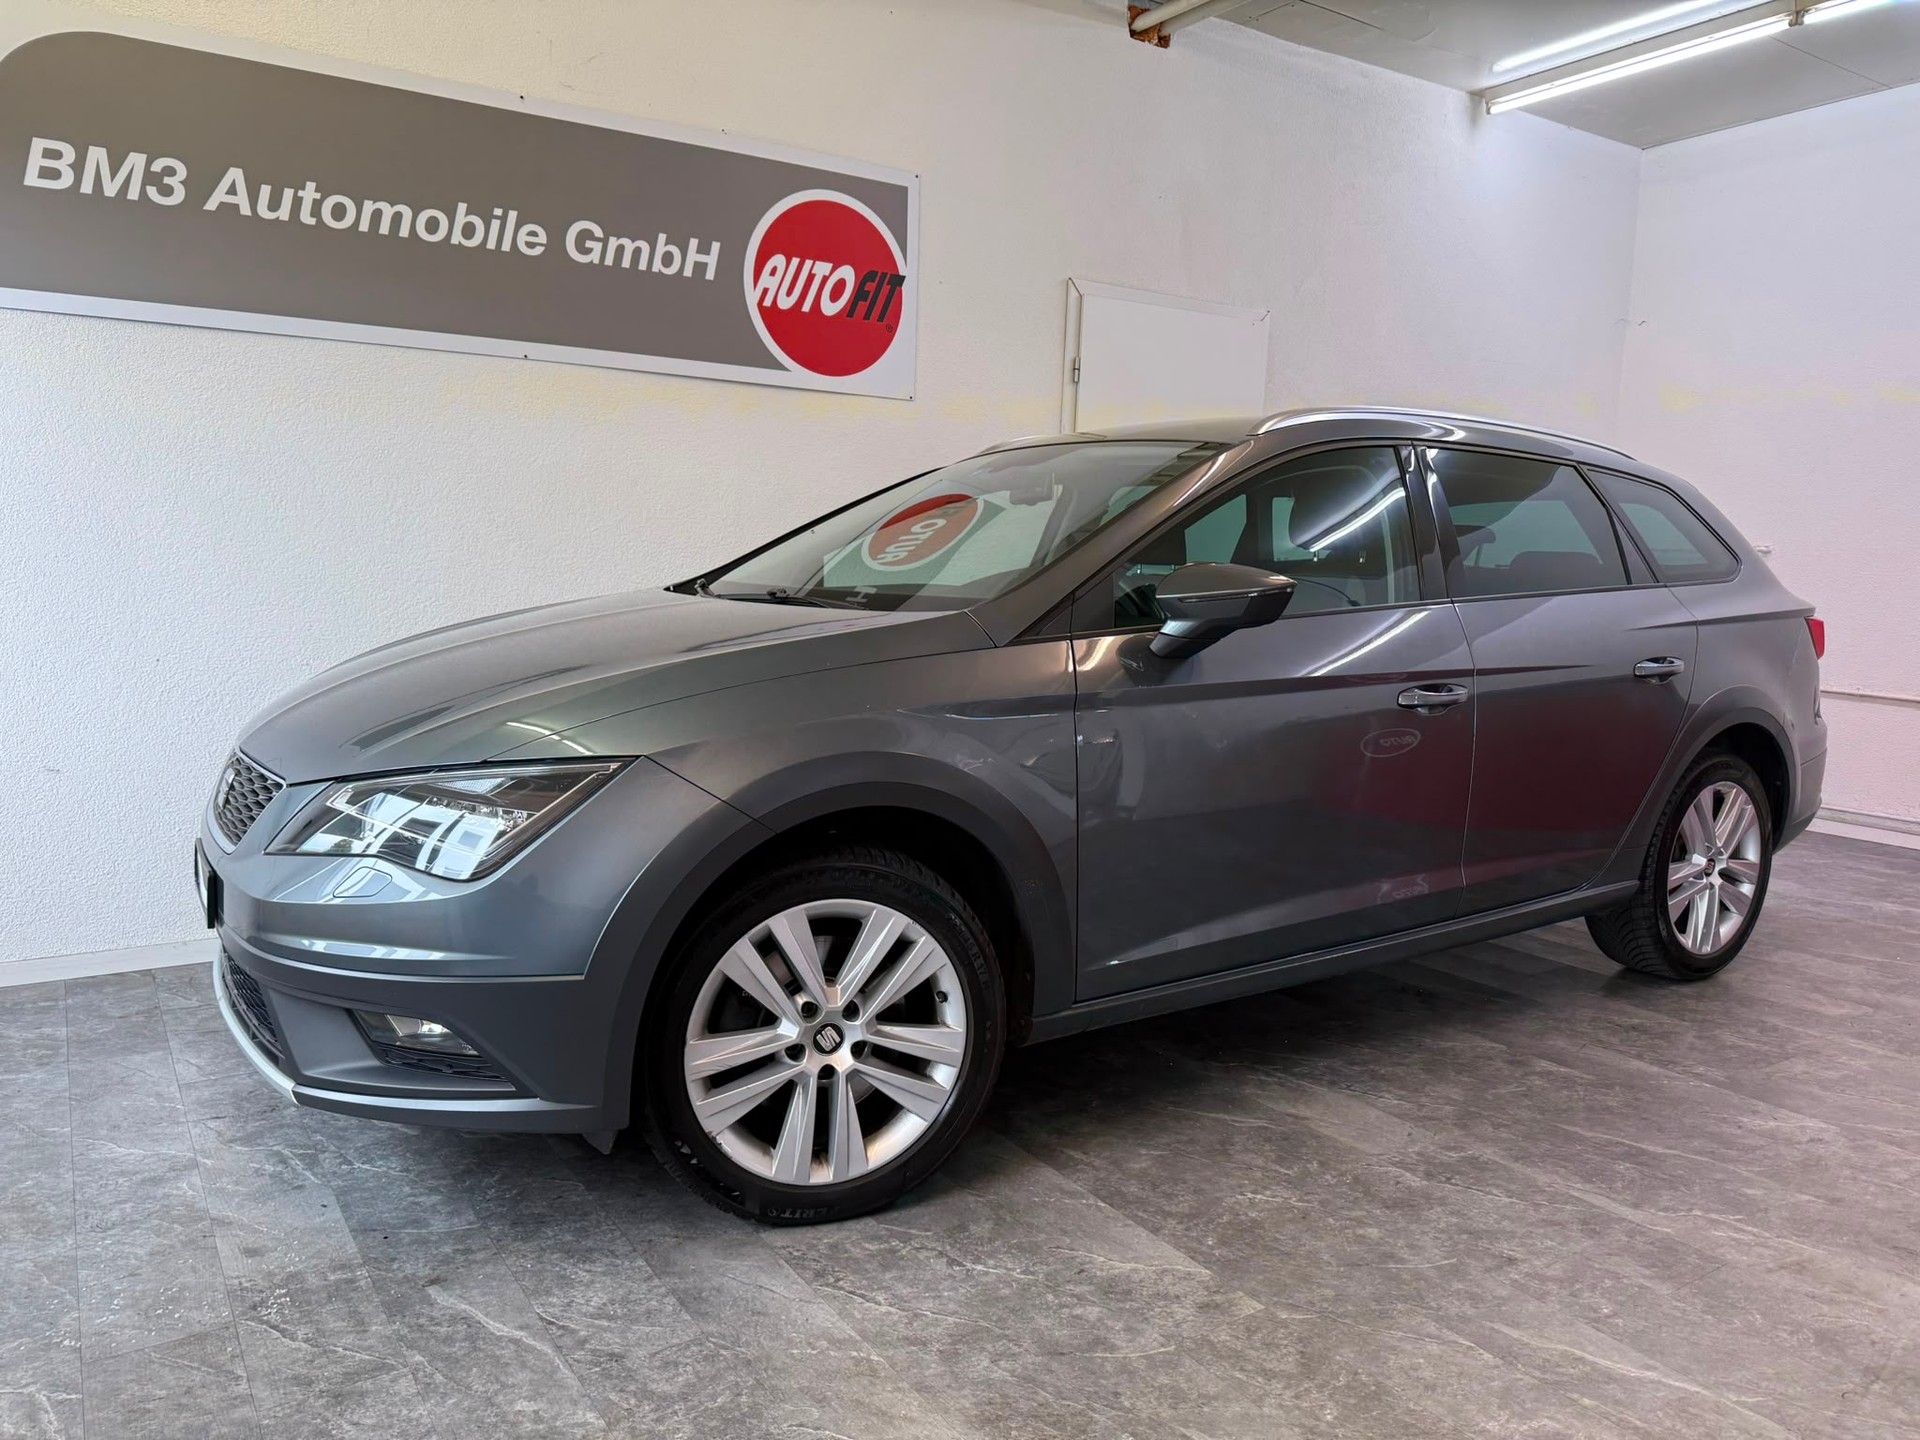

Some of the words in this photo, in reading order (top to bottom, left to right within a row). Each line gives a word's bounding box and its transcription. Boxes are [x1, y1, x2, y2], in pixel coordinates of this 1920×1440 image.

[23, 136, 189, 206] BM3
[202, 166, 548, 257] Automobile
[565, 219, 721, 281] GmbH
